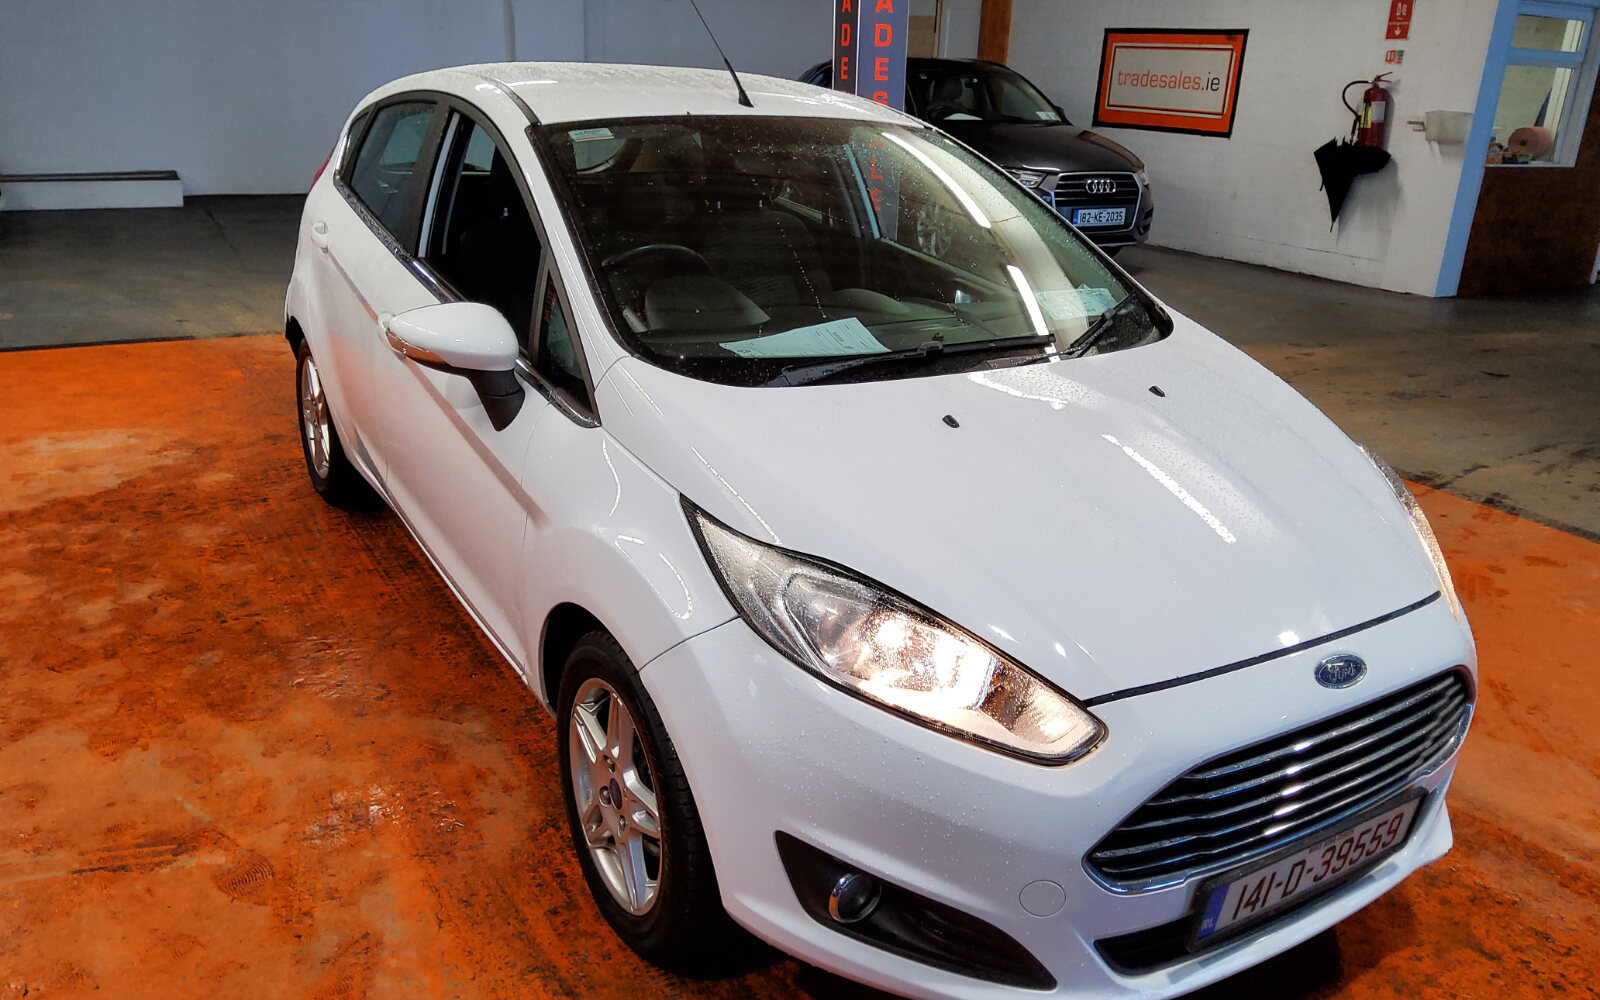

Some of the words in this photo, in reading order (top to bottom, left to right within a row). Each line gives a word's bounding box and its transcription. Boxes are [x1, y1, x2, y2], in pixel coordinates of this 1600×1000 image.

[840, 0, 851, 94] ADE
[1117, 68, 1220, 92] tradesales.ie
[1079, 211, 1124, 223] 182-KE-2035
[1232, 812, 1405, 921] 141-D-39559
